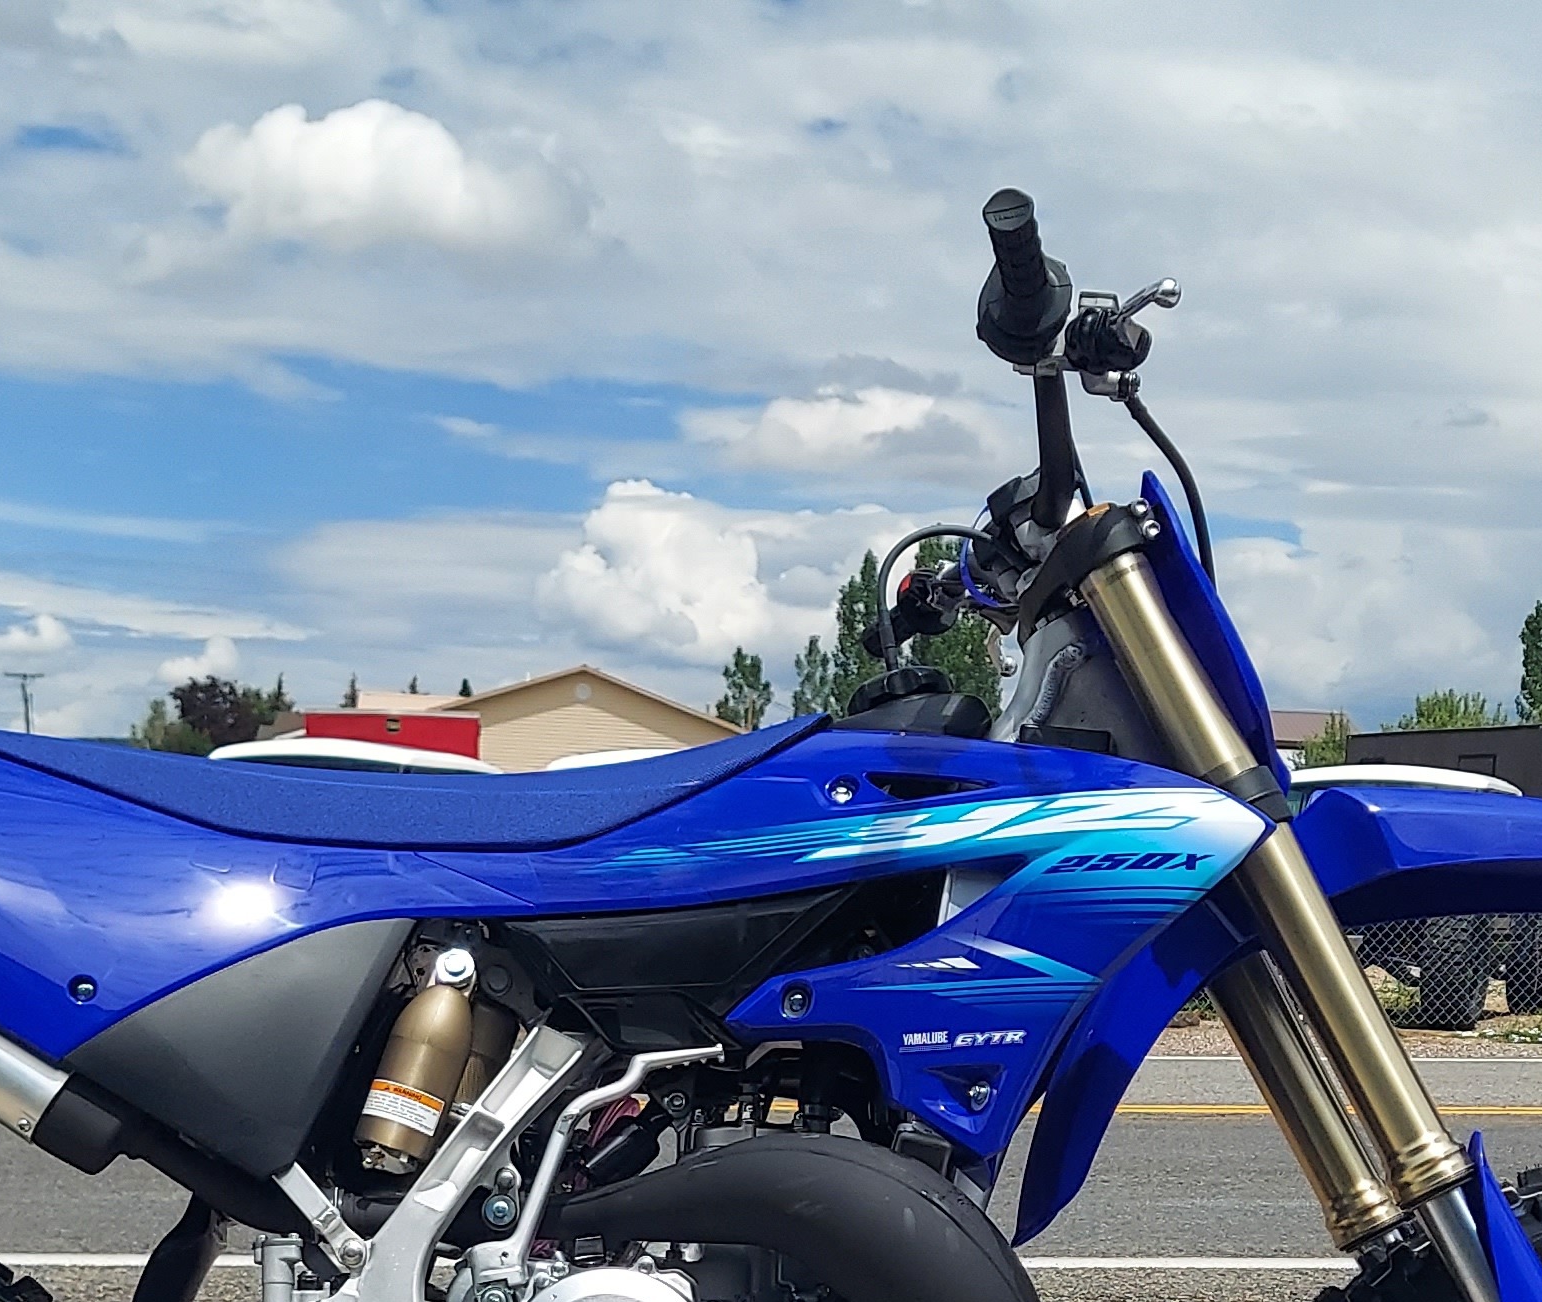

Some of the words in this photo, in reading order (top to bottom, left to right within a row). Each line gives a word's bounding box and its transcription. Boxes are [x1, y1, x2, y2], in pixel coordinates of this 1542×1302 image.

[1042, 852, 1216, 875] 250X
[902, 1030, 949, 1046] YAMALUBE
[953, 1029, 1027, 1048] GYTR
